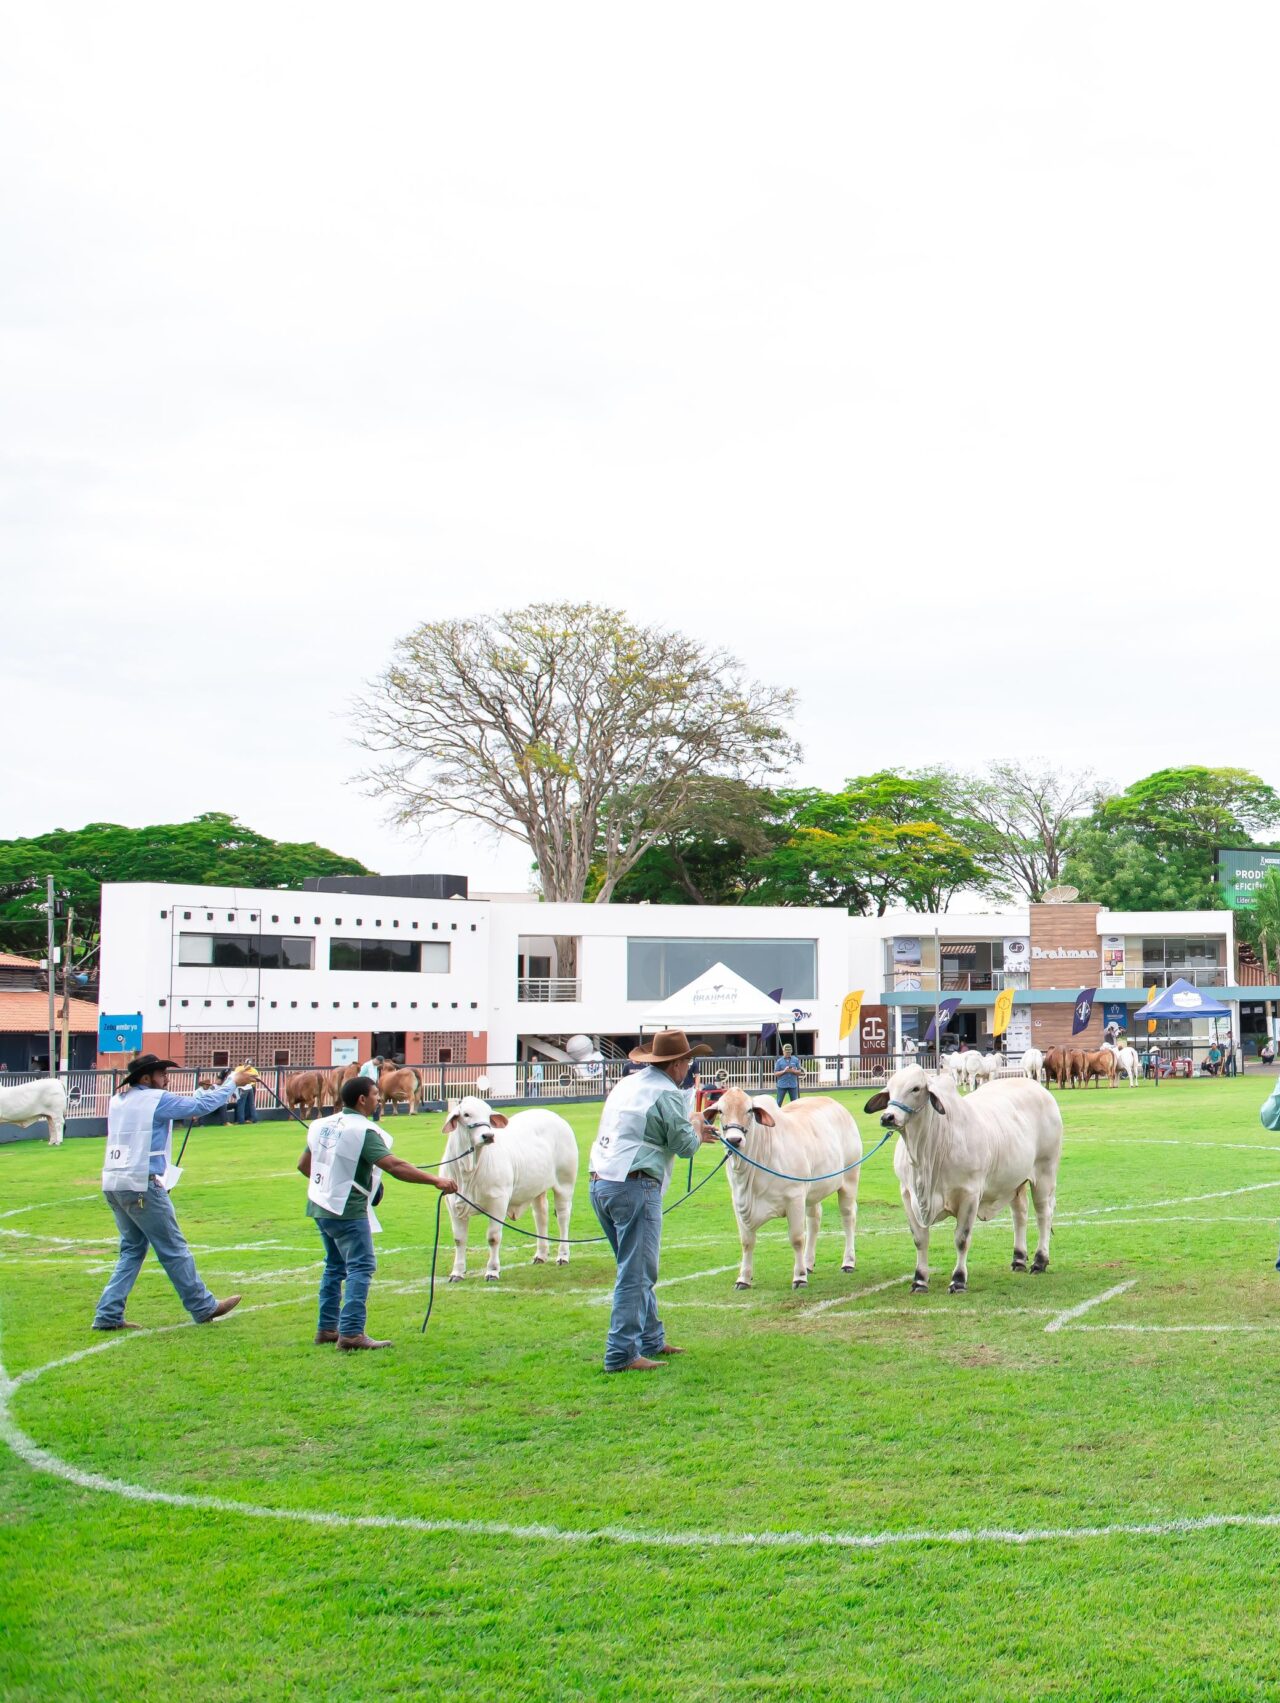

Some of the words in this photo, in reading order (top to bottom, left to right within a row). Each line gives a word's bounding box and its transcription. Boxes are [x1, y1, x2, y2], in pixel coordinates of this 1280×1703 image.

[1031, 946, 1098, 959] Brahman
[862, 1040, 886, 1049] LINCE
[110, 1149, 121, 1160] 10
